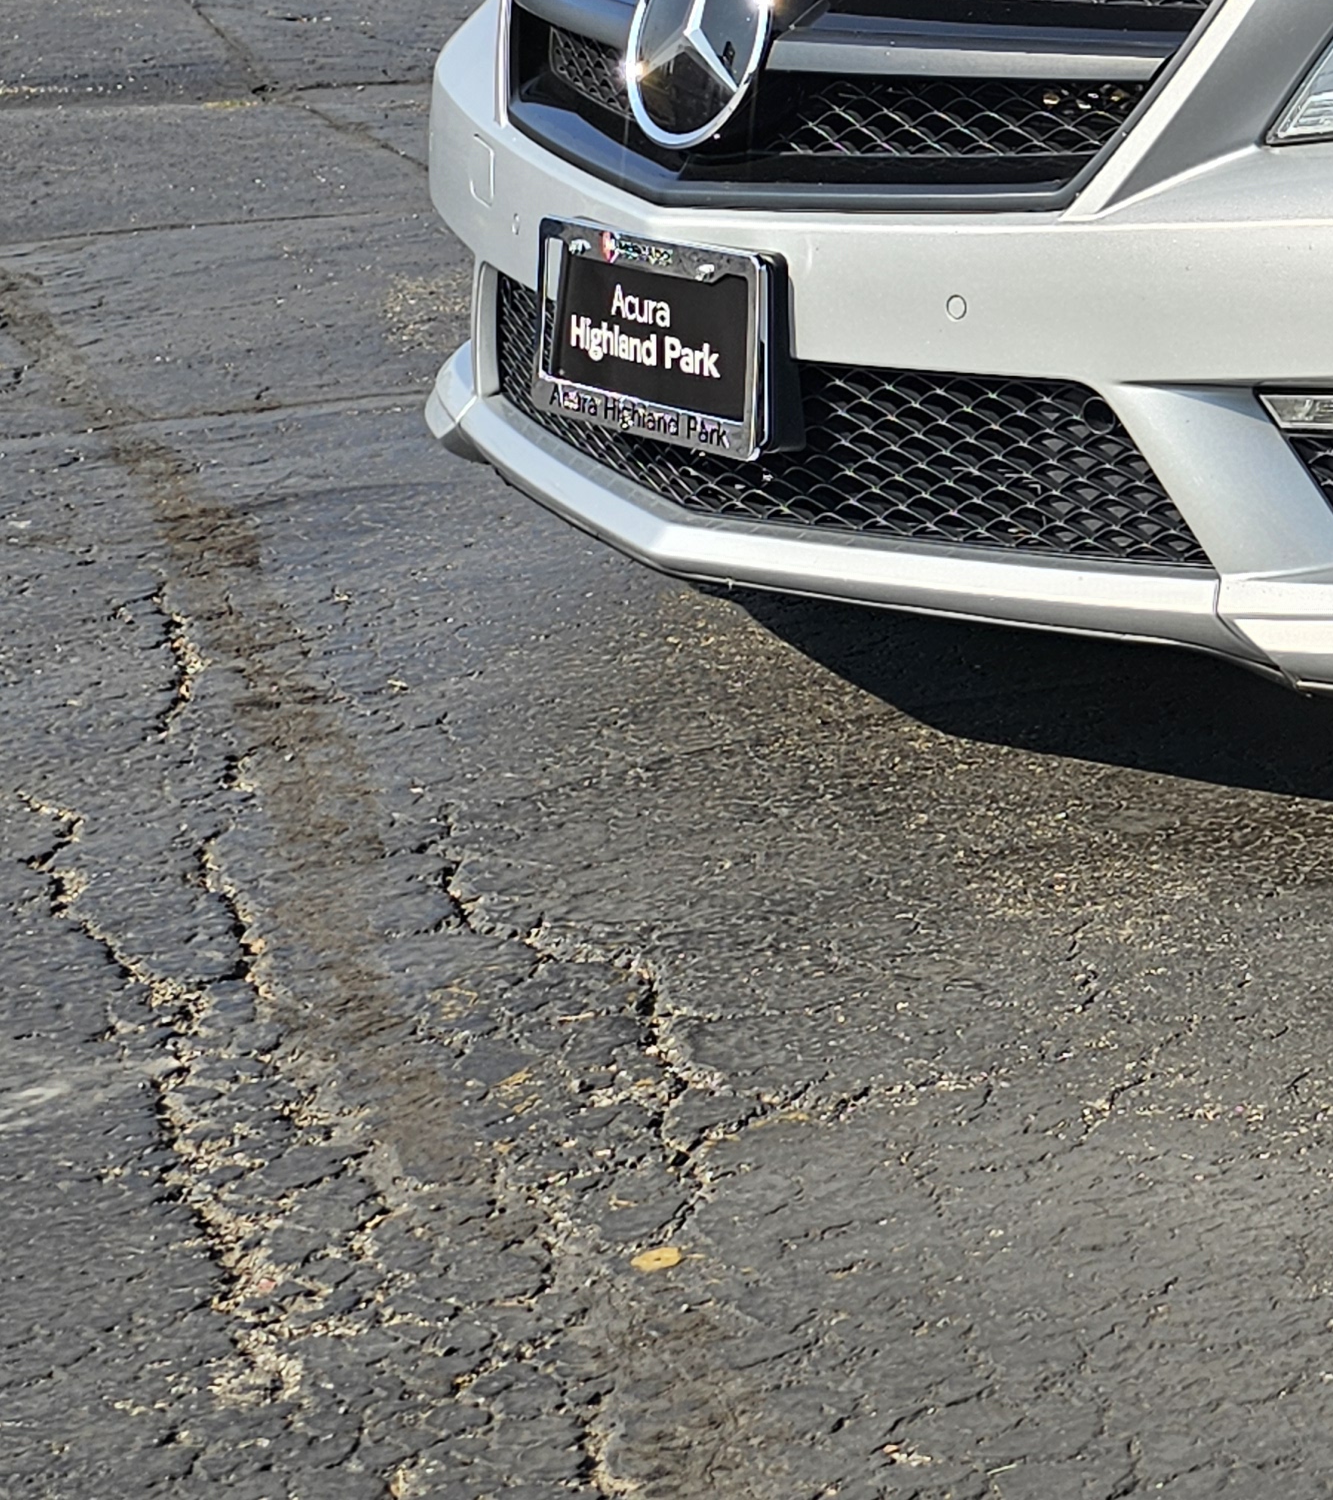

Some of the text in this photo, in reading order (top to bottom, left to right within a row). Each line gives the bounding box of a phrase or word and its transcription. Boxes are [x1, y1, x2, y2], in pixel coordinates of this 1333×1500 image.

[610, 283, 671, 328] Acura
[570, 314, 721, 379] Highland Park
[549, 383, 731, 449] Acura Highland Park
